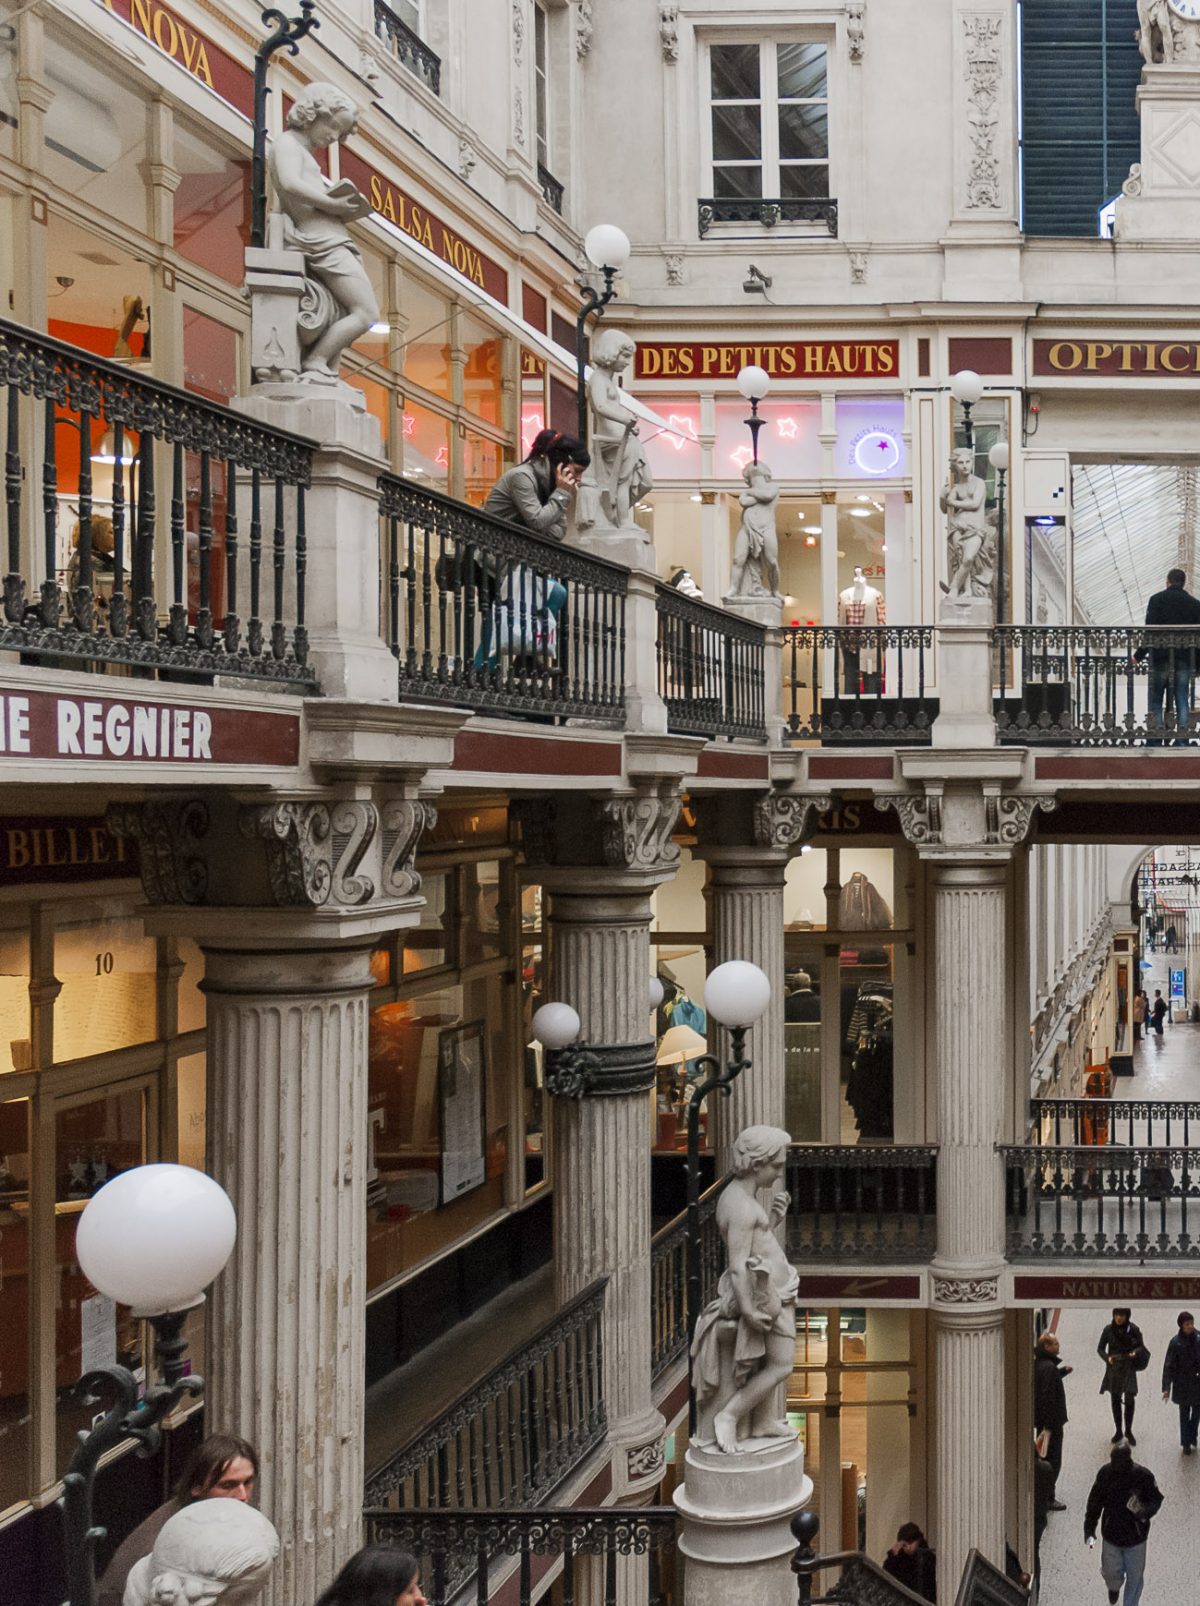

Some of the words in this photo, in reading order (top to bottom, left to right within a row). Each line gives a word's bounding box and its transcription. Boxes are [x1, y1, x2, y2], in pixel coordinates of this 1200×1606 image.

[131, 0, 215, 89] NOVA
[370, 175, 434, 251] SALSA
[442, 229, 485, 288] NOVA
[641, 347, 694, 375] DES
[701, 346, 797, 374] PETITS
[803, 345, 893, 373] HAUTS
[57, 699, 213, 759] REGNIER
[95, 951, 114, 977] 10
[1062, 1281, 1145, 1298] NATURE
[1150, 1281, 1166, 1298] &
